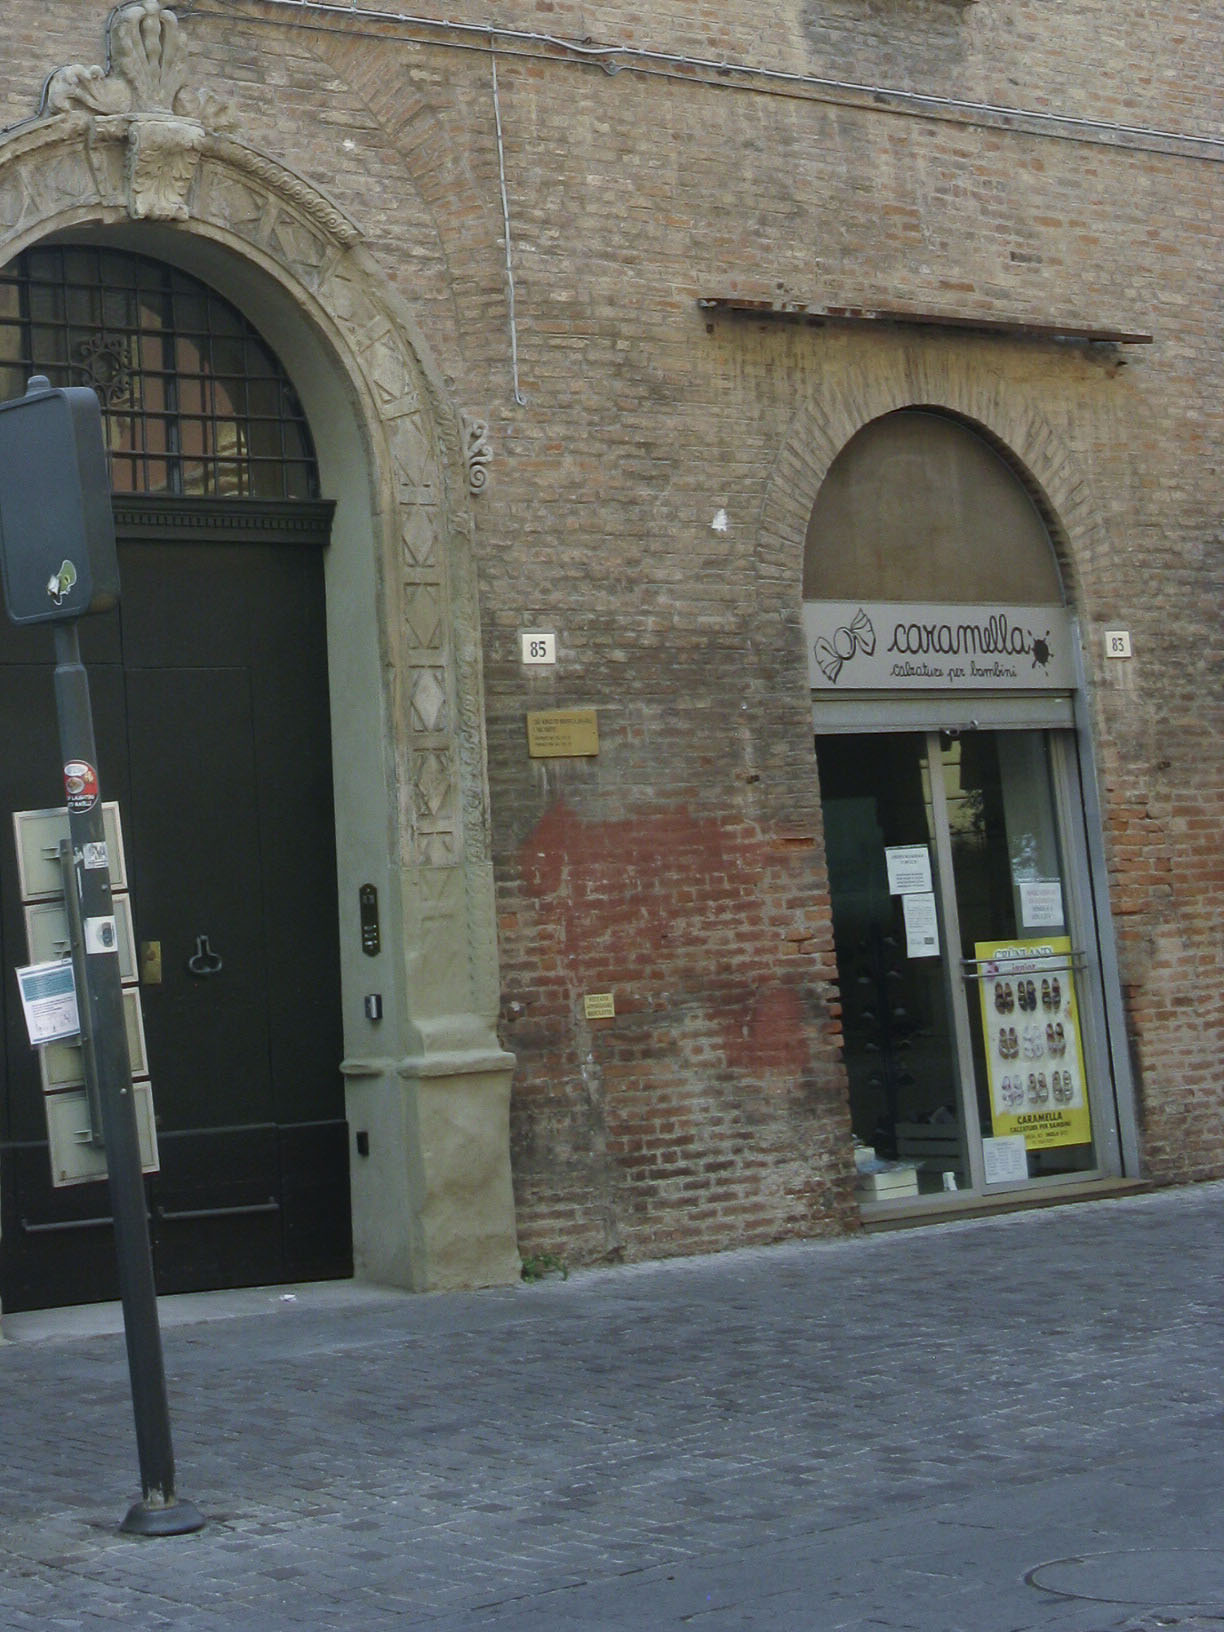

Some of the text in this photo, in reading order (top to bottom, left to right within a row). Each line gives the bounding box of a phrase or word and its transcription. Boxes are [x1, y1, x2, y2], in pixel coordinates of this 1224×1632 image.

[887, 614, 1031, 655] caramella
[530, 640, 547, 658] 85
[1111, 637, 1125, 652] 83
[947, 667, 966, 683] per
[971, 660, 1018, 678] bambini
[1017, 1112, 1063, 1124] CARAMELLA
